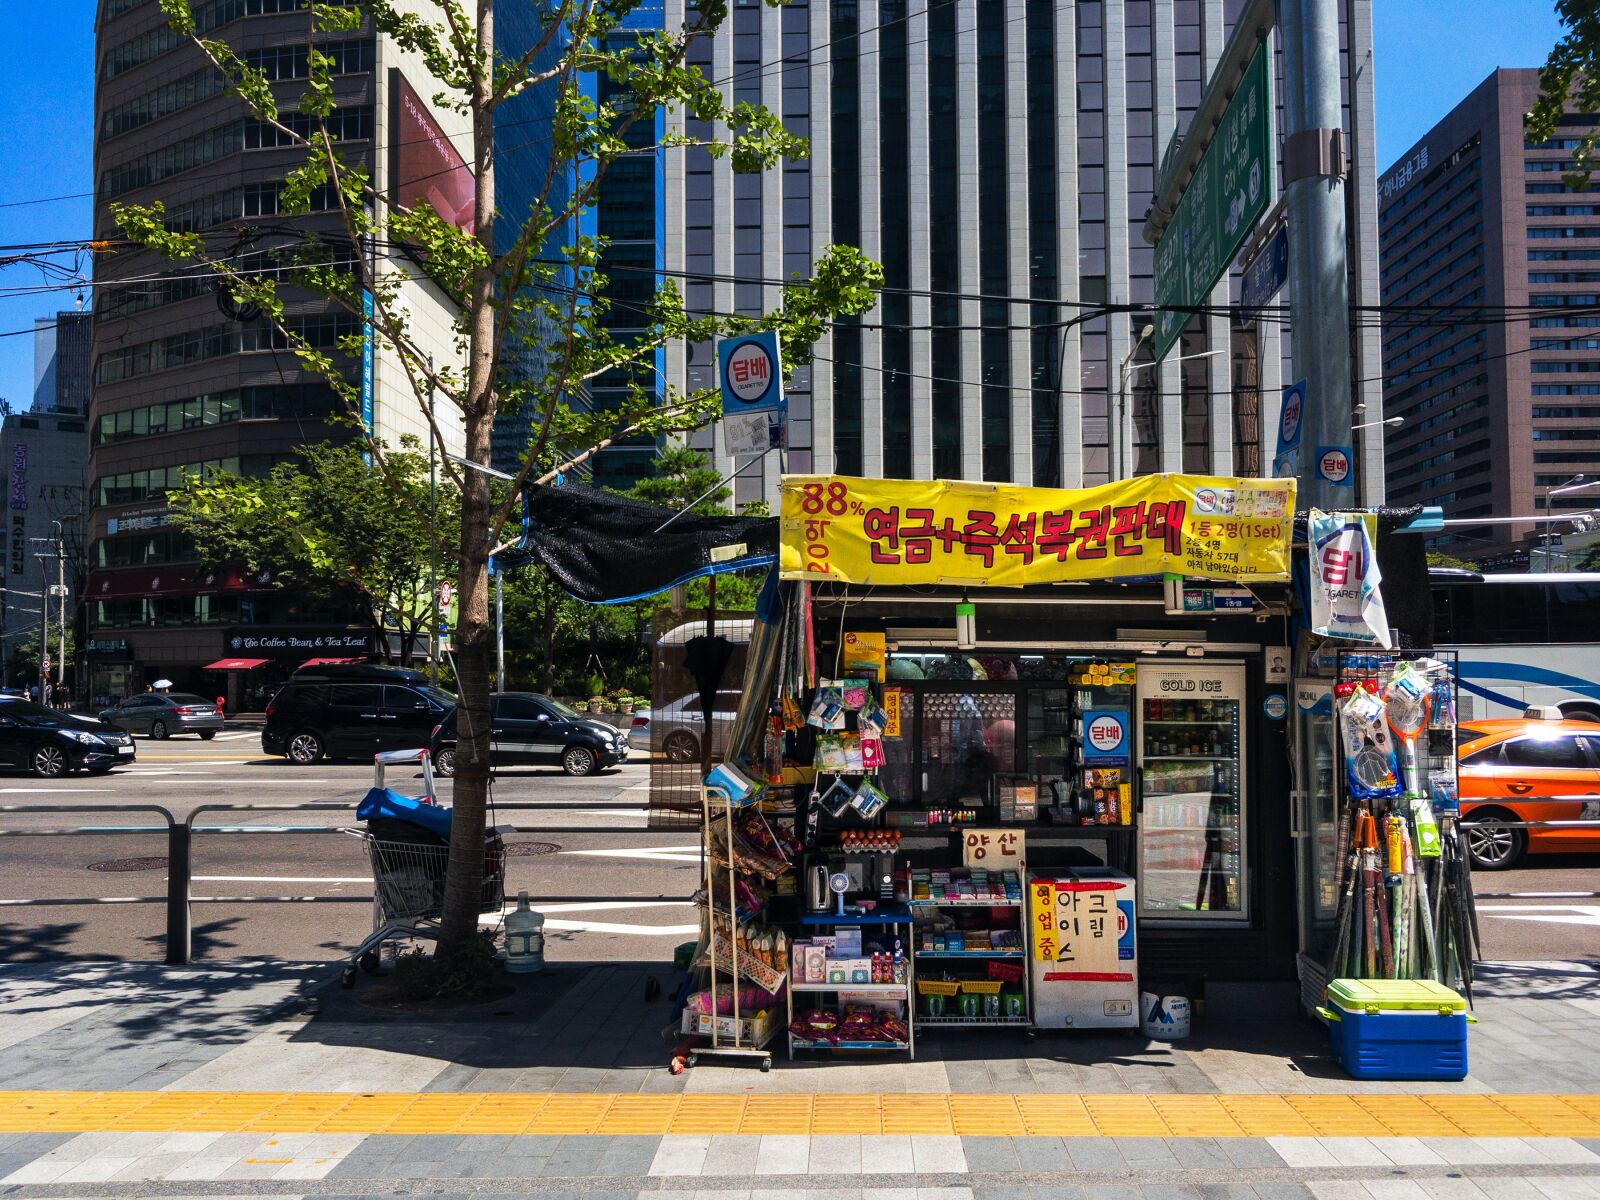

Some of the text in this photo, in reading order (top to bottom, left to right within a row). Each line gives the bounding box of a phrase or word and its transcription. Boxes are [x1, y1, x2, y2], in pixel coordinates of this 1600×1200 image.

[1223, 111, 1239, 166] 시청
[1224, 136, 1249, 196] City Hall
[1384, 146, 1428, 198] 하나금융그룹
[733, 356, 768, 382] 담배
[1284, 401, 1300, 426] 담배
[1323, 459, 1347, 472] 담배
[802, 482, 866, 516] 88%
[863, 500, 1187, 568] 연금+즉석복권판매
[1190, 521, 1281, 539] 1등 2명(1Set)
[804, 520, 830, 573] 20억
[1205, 540, 1221, 550] 4명
[1216, 552, 1239, 562] 57대
[1187, 560, 1203, 571] 아직
[244, 636, 368, 648] The Coffee Bean & Tea Leaf
[1160, 680, 1222, 692] GOLD ICE
[886, 694, 897, 734] 영업중
[1527, 708, 1540, 718] TAXI
[1091, 726, 1120, 740] 담배
[1036, 884, 1056, 957] 영업중
